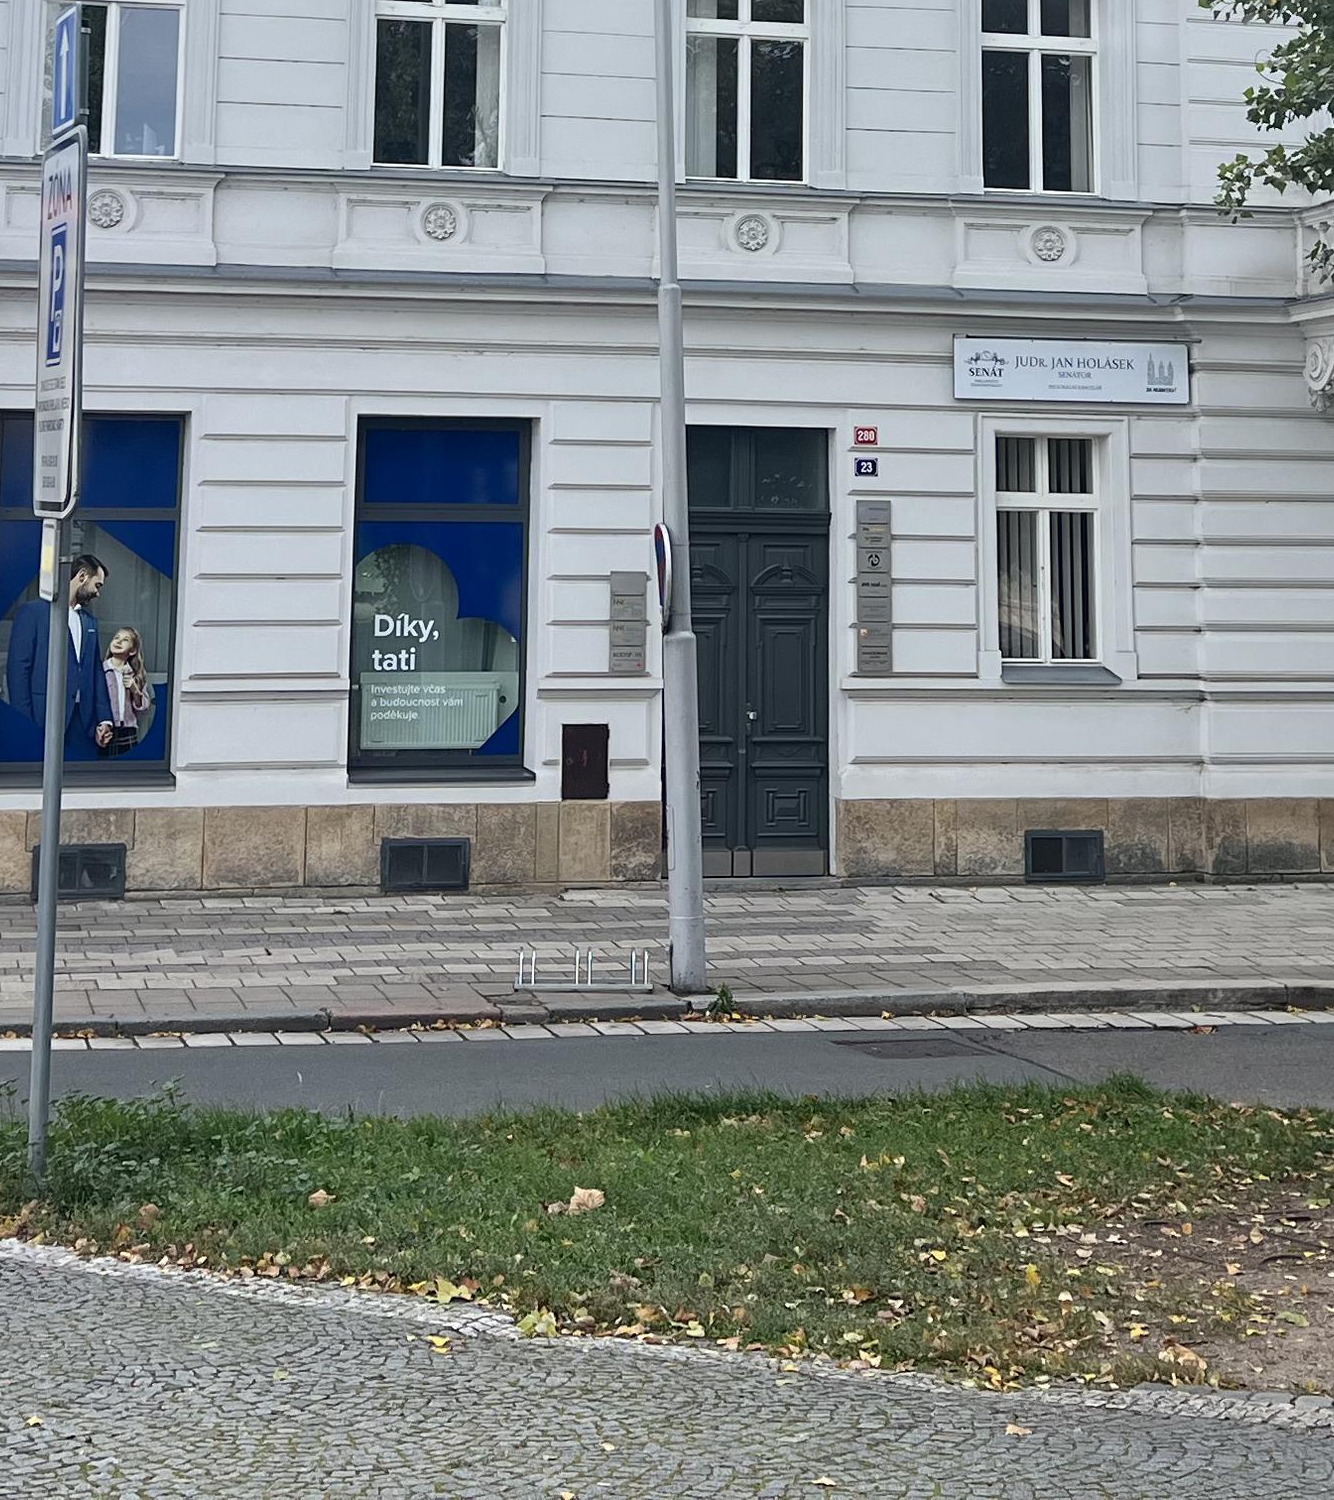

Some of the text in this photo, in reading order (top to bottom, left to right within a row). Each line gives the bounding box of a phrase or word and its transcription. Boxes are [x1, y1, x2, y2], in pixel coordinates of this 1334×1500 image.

[47, 160, 72, 220] ZÓNA
[50, 244, 63, 322] P
[1051, 356, 1074, 370] JAN
[1077, 355, 1135, 370] HOLÁSEK
[968, 366, 1004, 377] SENÁT
[860, 461, 873, 473] 23
[373, 612, 440, 643] Díky,
[371, 647, 417, 671] tati
[370, 684, 447, 696] Investujte včas
[379, 697, 440, 707] budoucnost
[442, 697, 464, 707] vám
